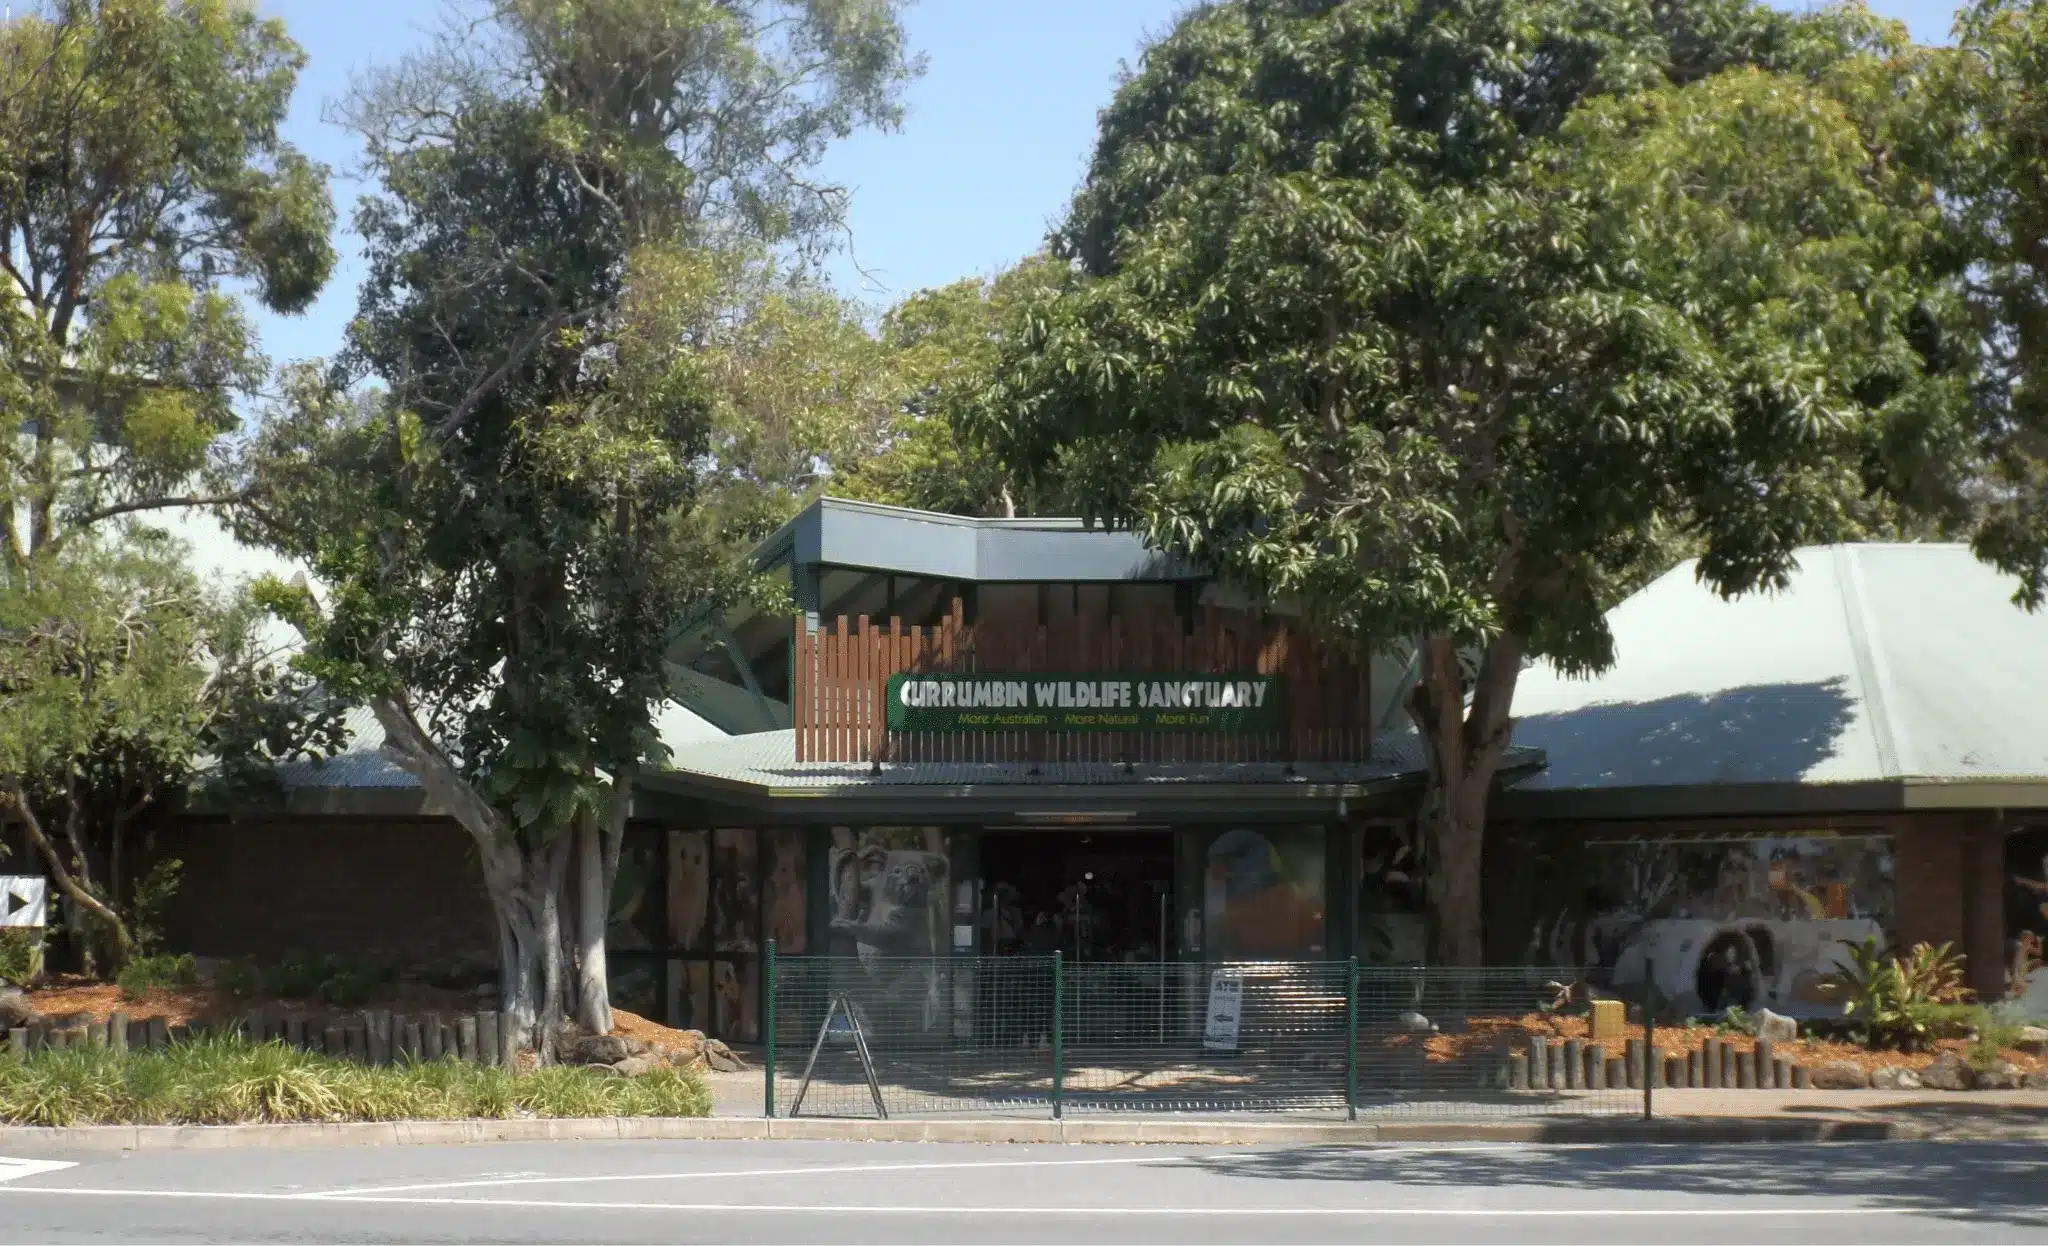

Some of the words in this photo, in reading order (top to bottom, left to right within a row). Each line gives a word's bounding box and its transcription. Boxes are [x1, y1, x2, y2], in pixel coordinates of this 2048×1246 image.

[900, 680, 1028, 707] CURRUMBIN
[1034, 680, 1131, 707] WILDLIFE
[1140, 680, 1269, 707] SANCTUARY
[958, 713, 990, 725] More
[994, 713, 1047, 725] Australian
[1064, 713, 1097, 725] More
[1101, 713, 1138, 725] Natural
[1156, 713, 1187, 725] More
[1191, 713, 1210, 725] Fun
